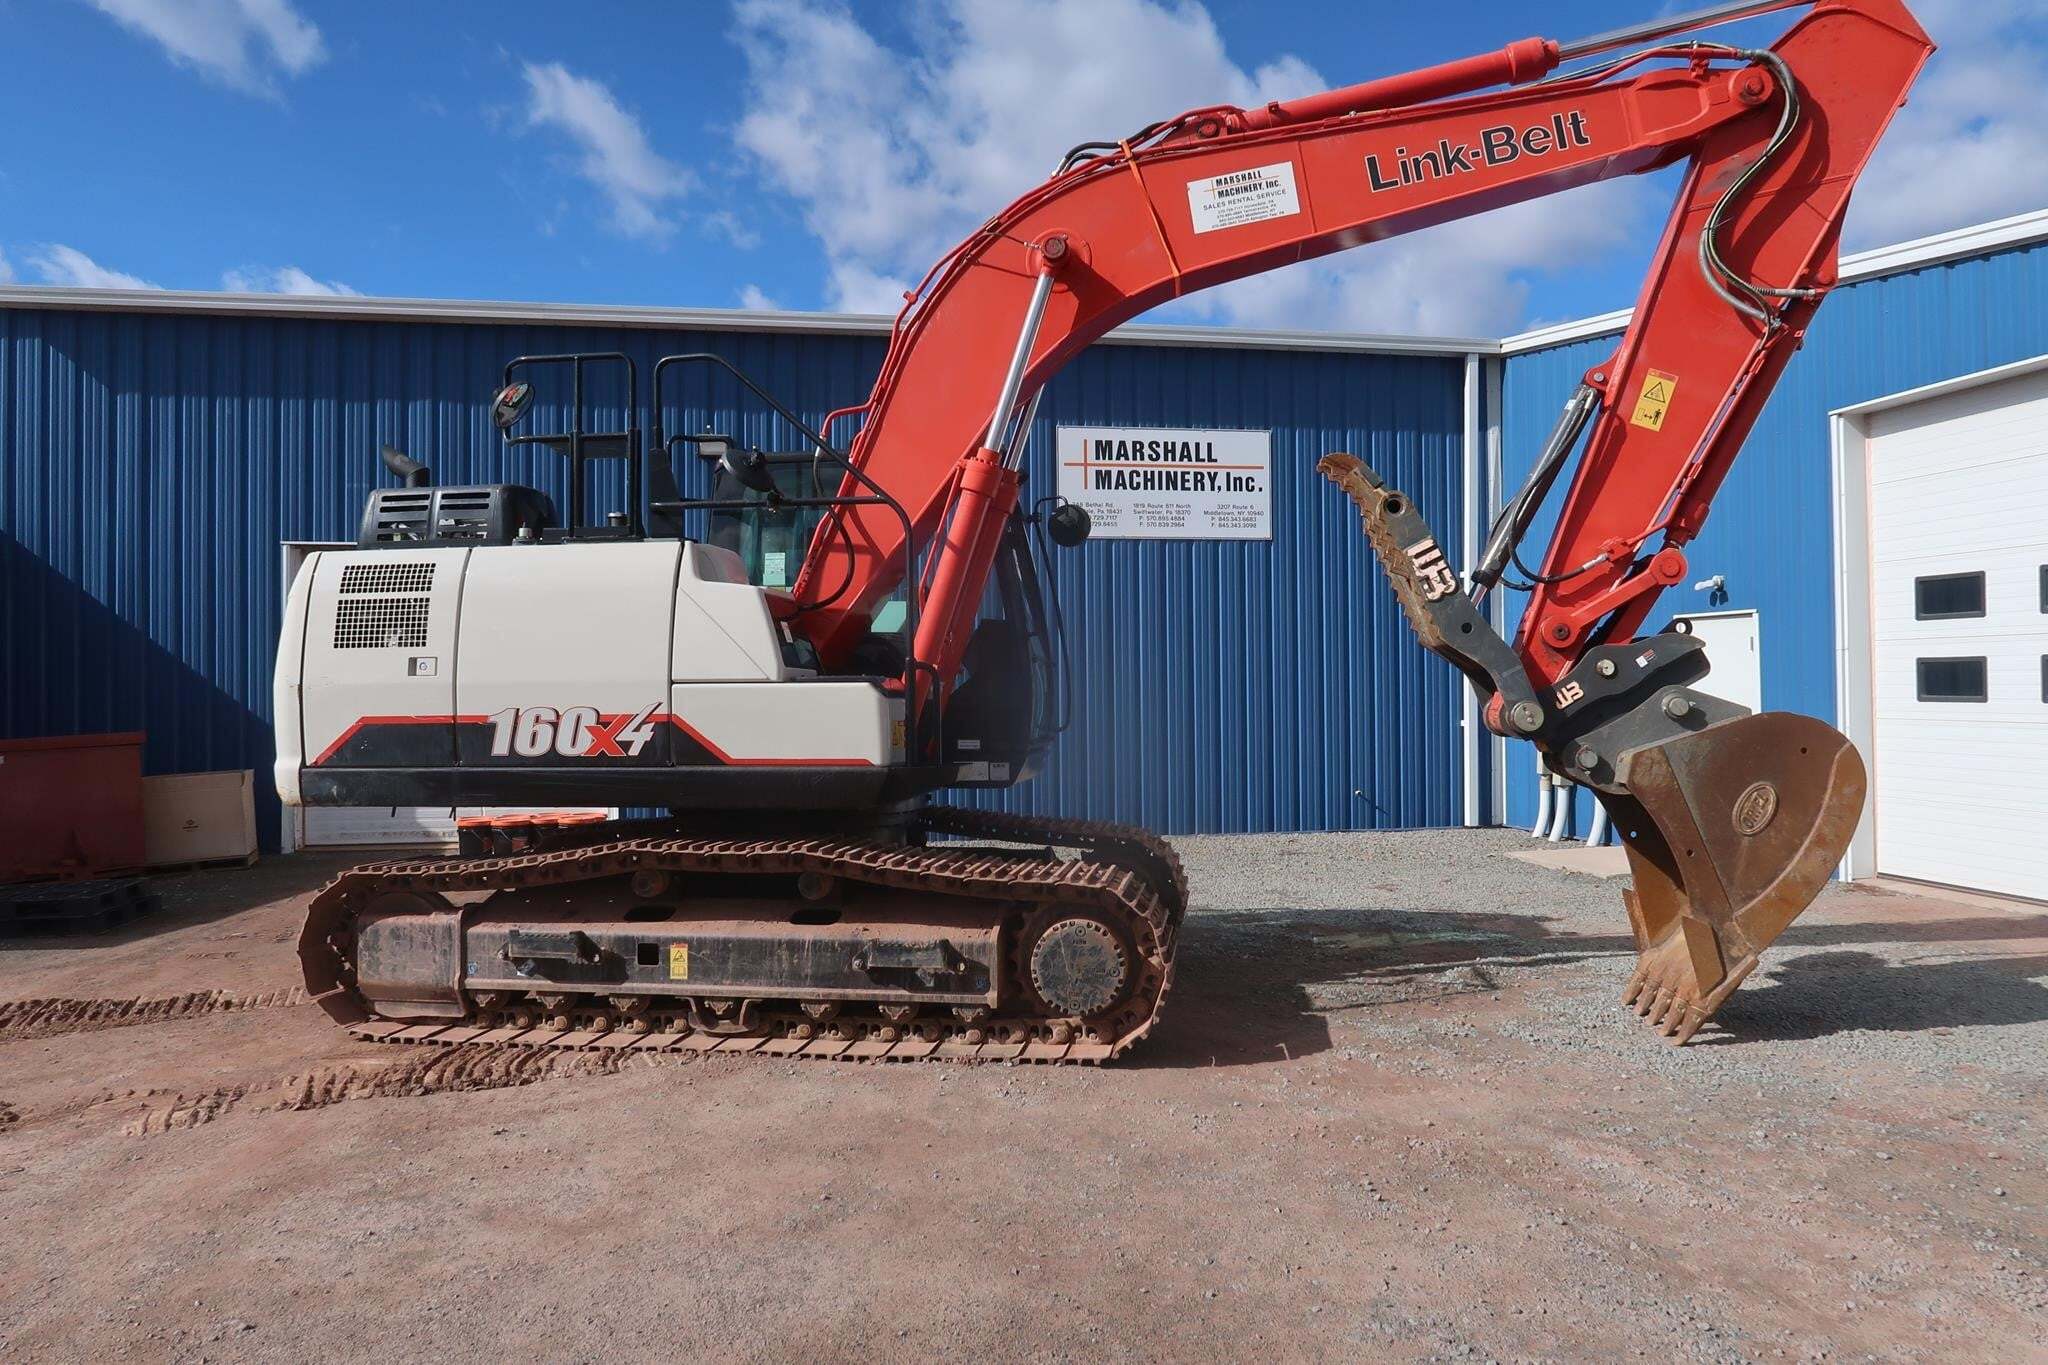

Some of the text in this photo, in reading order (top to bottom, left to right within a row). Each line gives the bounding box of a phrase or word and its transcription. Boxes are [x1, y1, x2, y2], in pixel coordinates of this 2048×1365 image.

[1365, 110, 1591, 193] Link-Belt
[1215, 170, 1262, 187] MARSHALL
[1265, 179, 1282, 190] Inc.
[1203, 201, 1226, 212] SALES
[1227, 194, 1256, 206] RENTAL
[1256, 188, 1288, 200] SERVICE
[1094, 439, 1218, 463] MARSHALL
[1095, 469, 1264, 493] MACHINERY, Inc.
